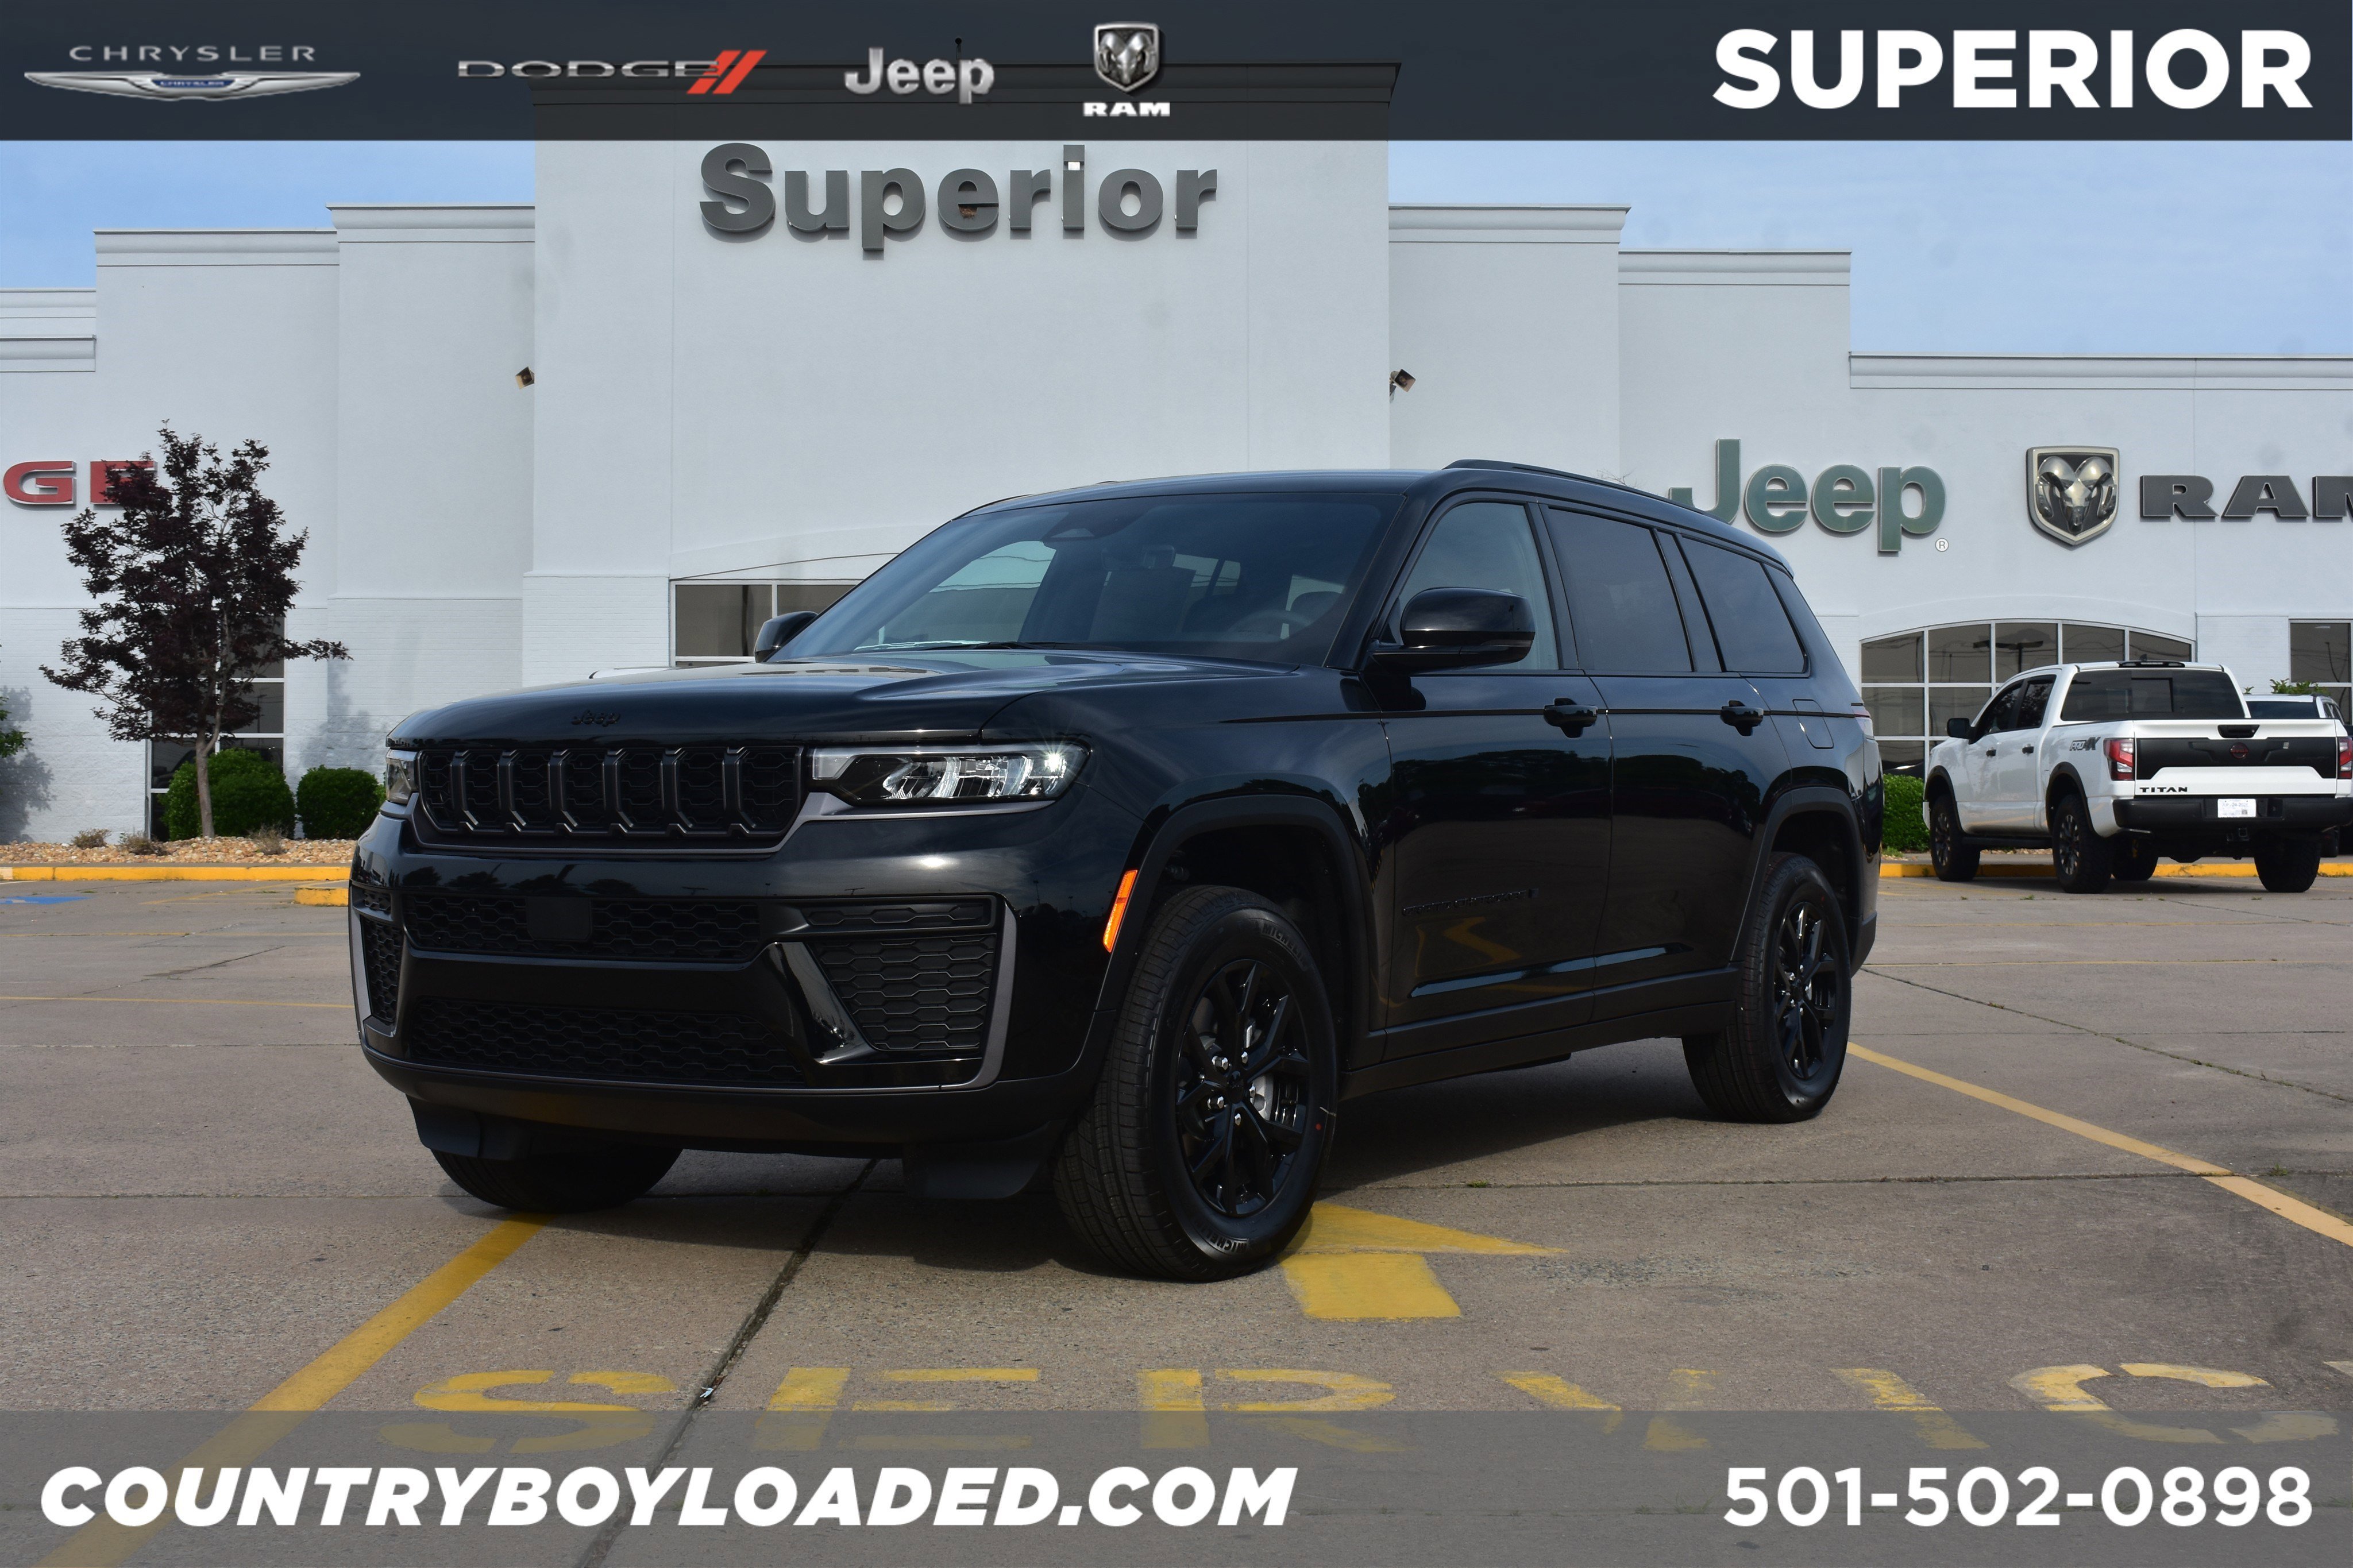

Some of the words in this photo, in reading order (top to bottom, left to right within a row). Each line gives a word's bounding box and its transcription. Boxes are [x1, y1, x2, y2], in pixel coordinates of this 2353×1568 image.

[700, 142, 1218, 251] Superior
[1668, 438, 1946, 553] Jeep
[570, 709, 621, 727] Jeep
[1263, 922, 1307, 968] MICHELIN
